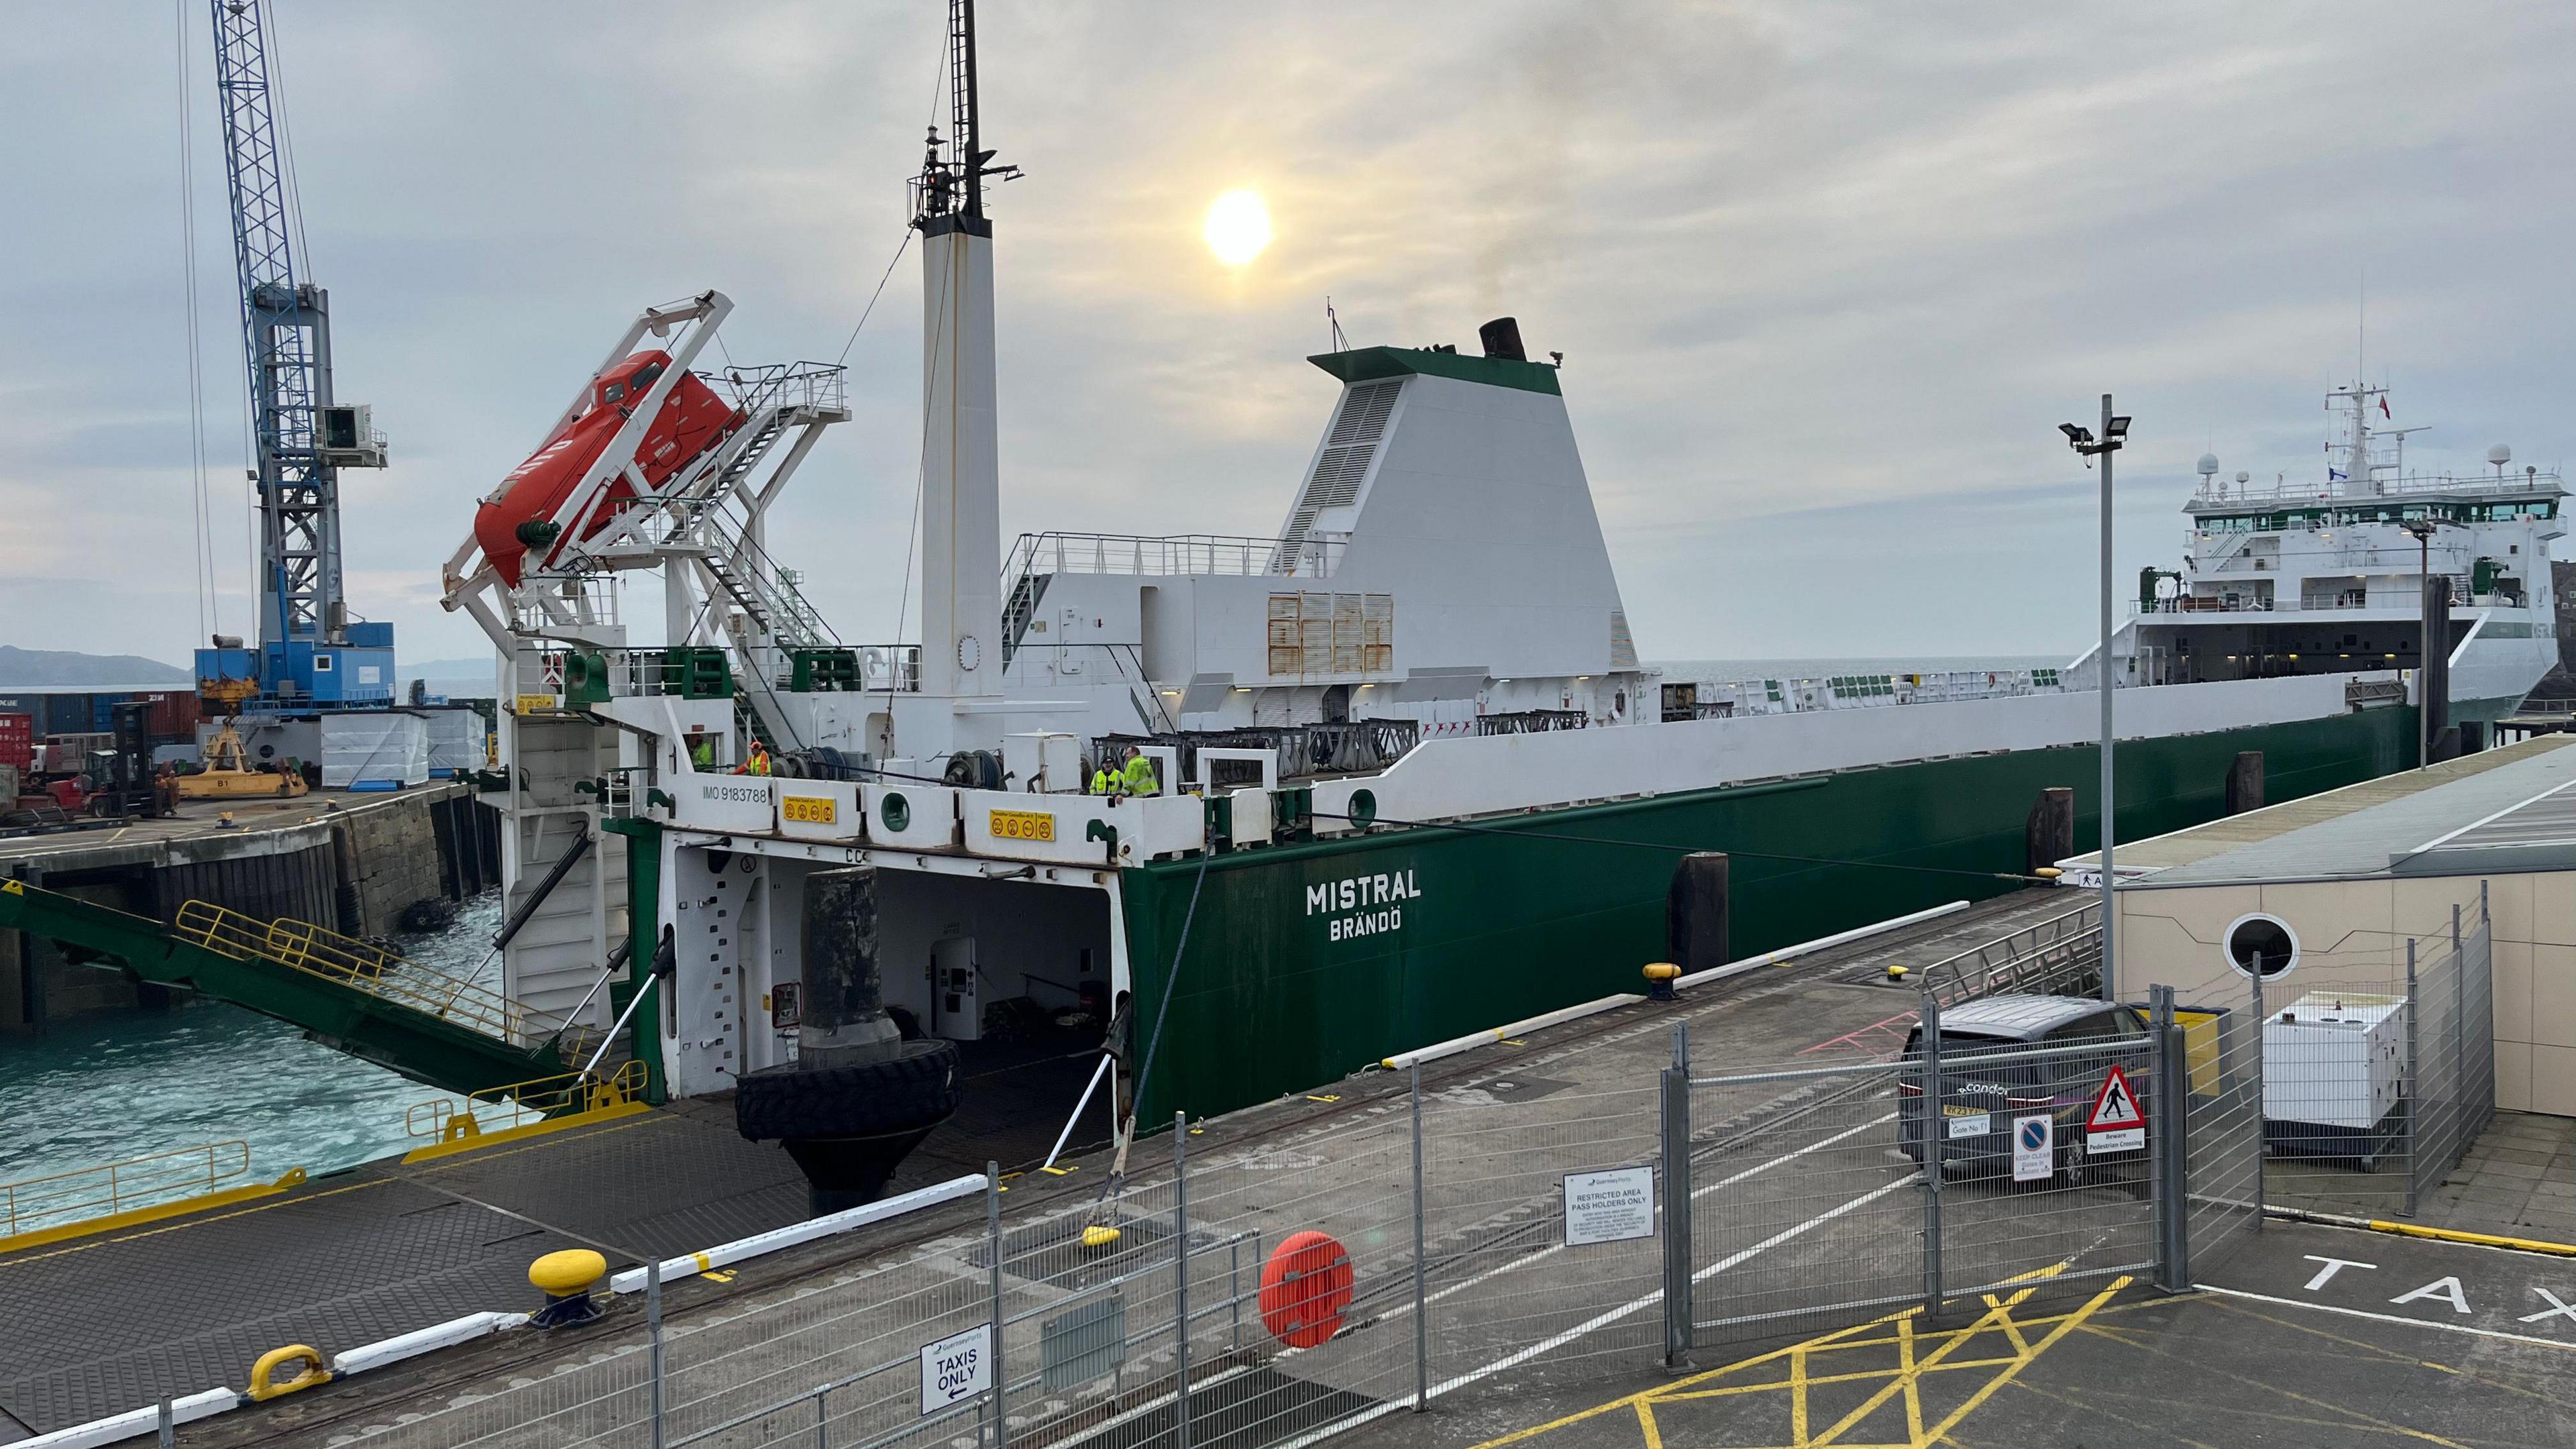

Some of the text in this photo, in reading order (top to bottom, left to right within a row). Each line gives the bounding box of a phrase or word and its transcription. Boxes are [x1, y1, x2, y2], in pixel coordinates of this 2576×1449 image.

[702, 786, 767, 803] IMO 9183788
[1306, 869, 1421, 916] MISTRAL
[1330, 905, 1401, 941] BRÄNDÖ
[1952, 1126, 1968, 1134] Gate
[2089, 1142, 2118, 1150] Pedestrian
[1576, 1188, 1642, 1202] RESTRICTED AREA
[1572, 1196, 1646, 1212] PASS HOLDERS ONLY
[936, 1348, 977, 1375] TAXIS
[938, 1364, 976, 1391] ONLY
